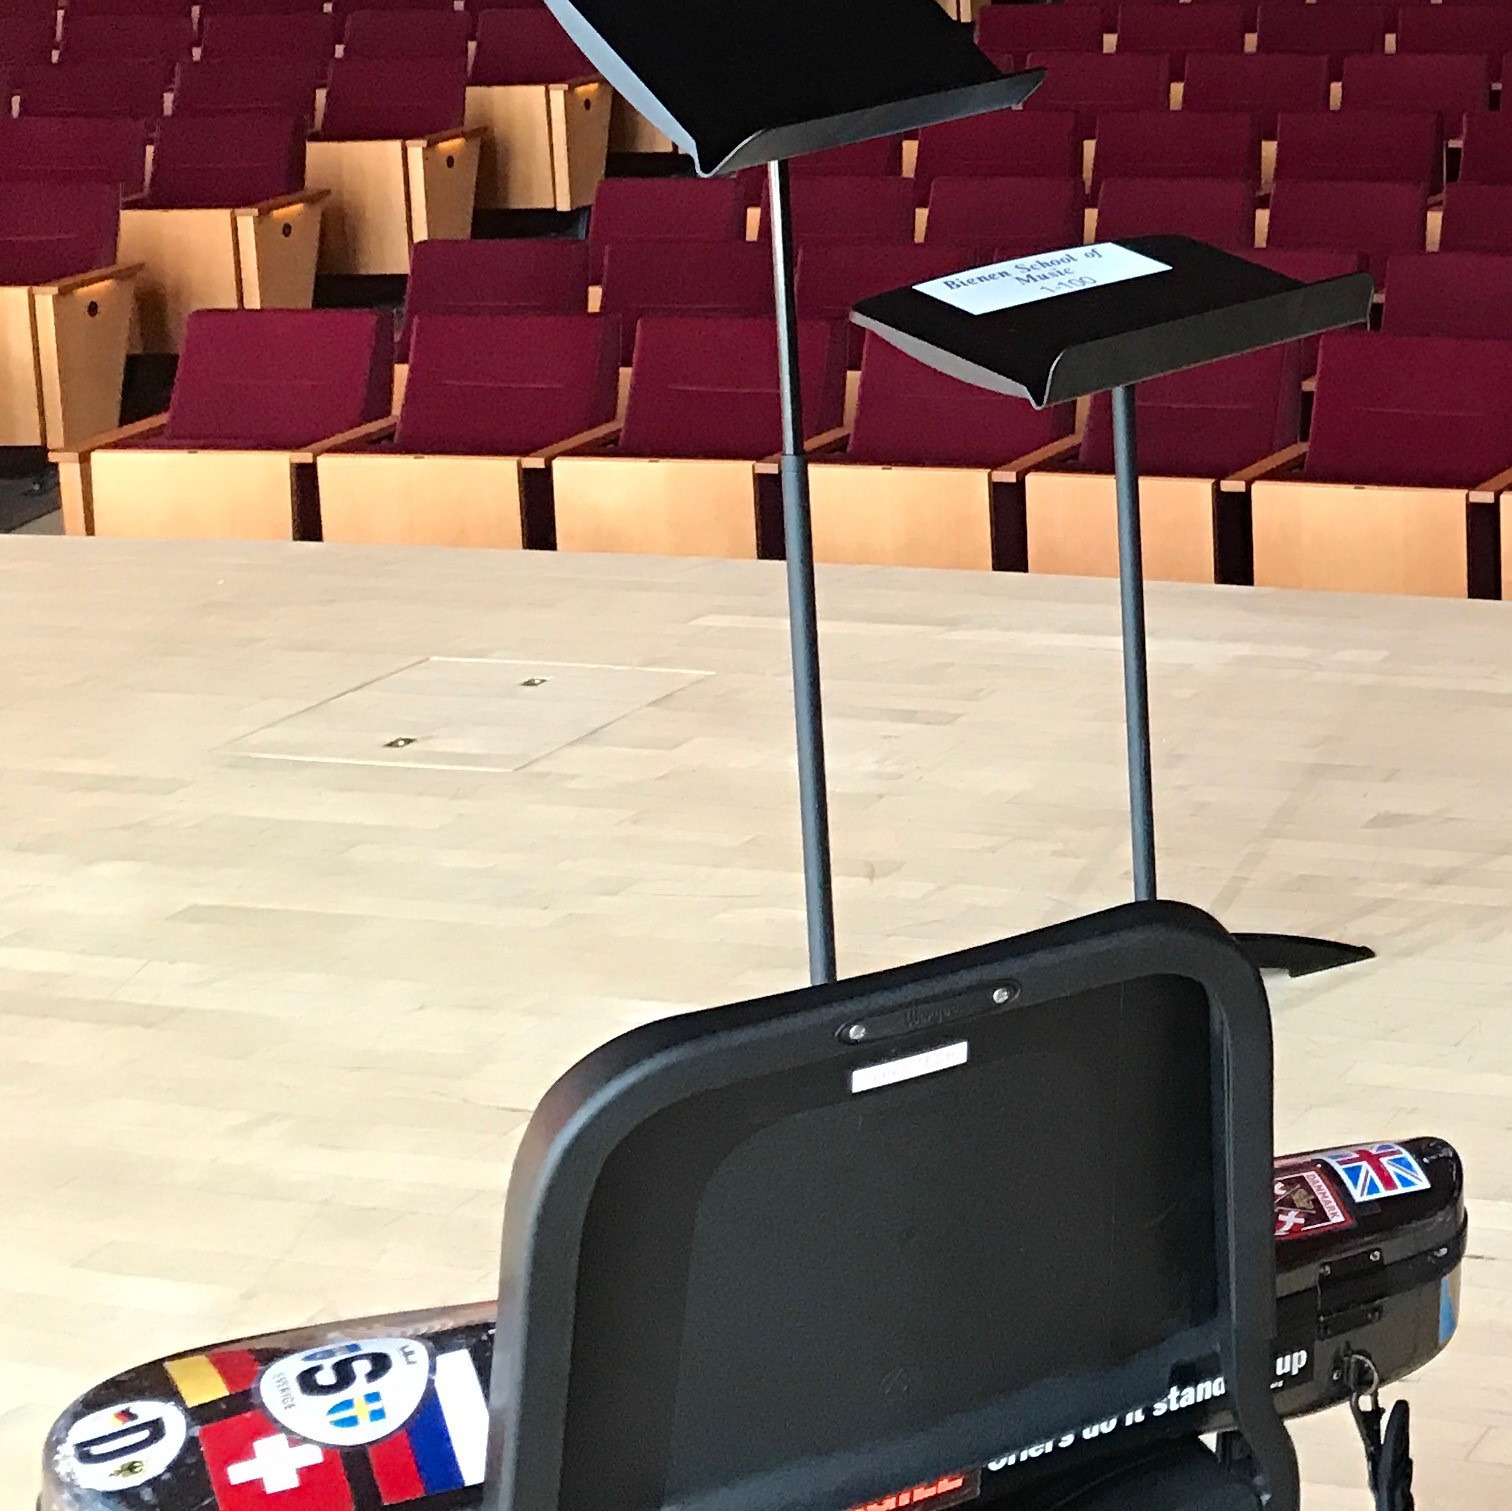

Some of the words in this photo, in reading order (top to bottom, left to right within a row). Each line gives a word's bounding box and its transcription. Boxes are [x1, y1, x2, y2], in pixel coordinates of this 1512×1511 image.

[943, 270, 1012, 290] Bienen
[1014, 253, 1078, 273] School
[1083, 247, 1103, 259] of
[1014, 267, 1075, 286] Music
[1039, 275, 1098, 293] 1-100
[1305, 1173, 1341, 1219] DANMARK
[295, 1351, 394, 1397] S
[1275, 1346, 1308, 1380] up
